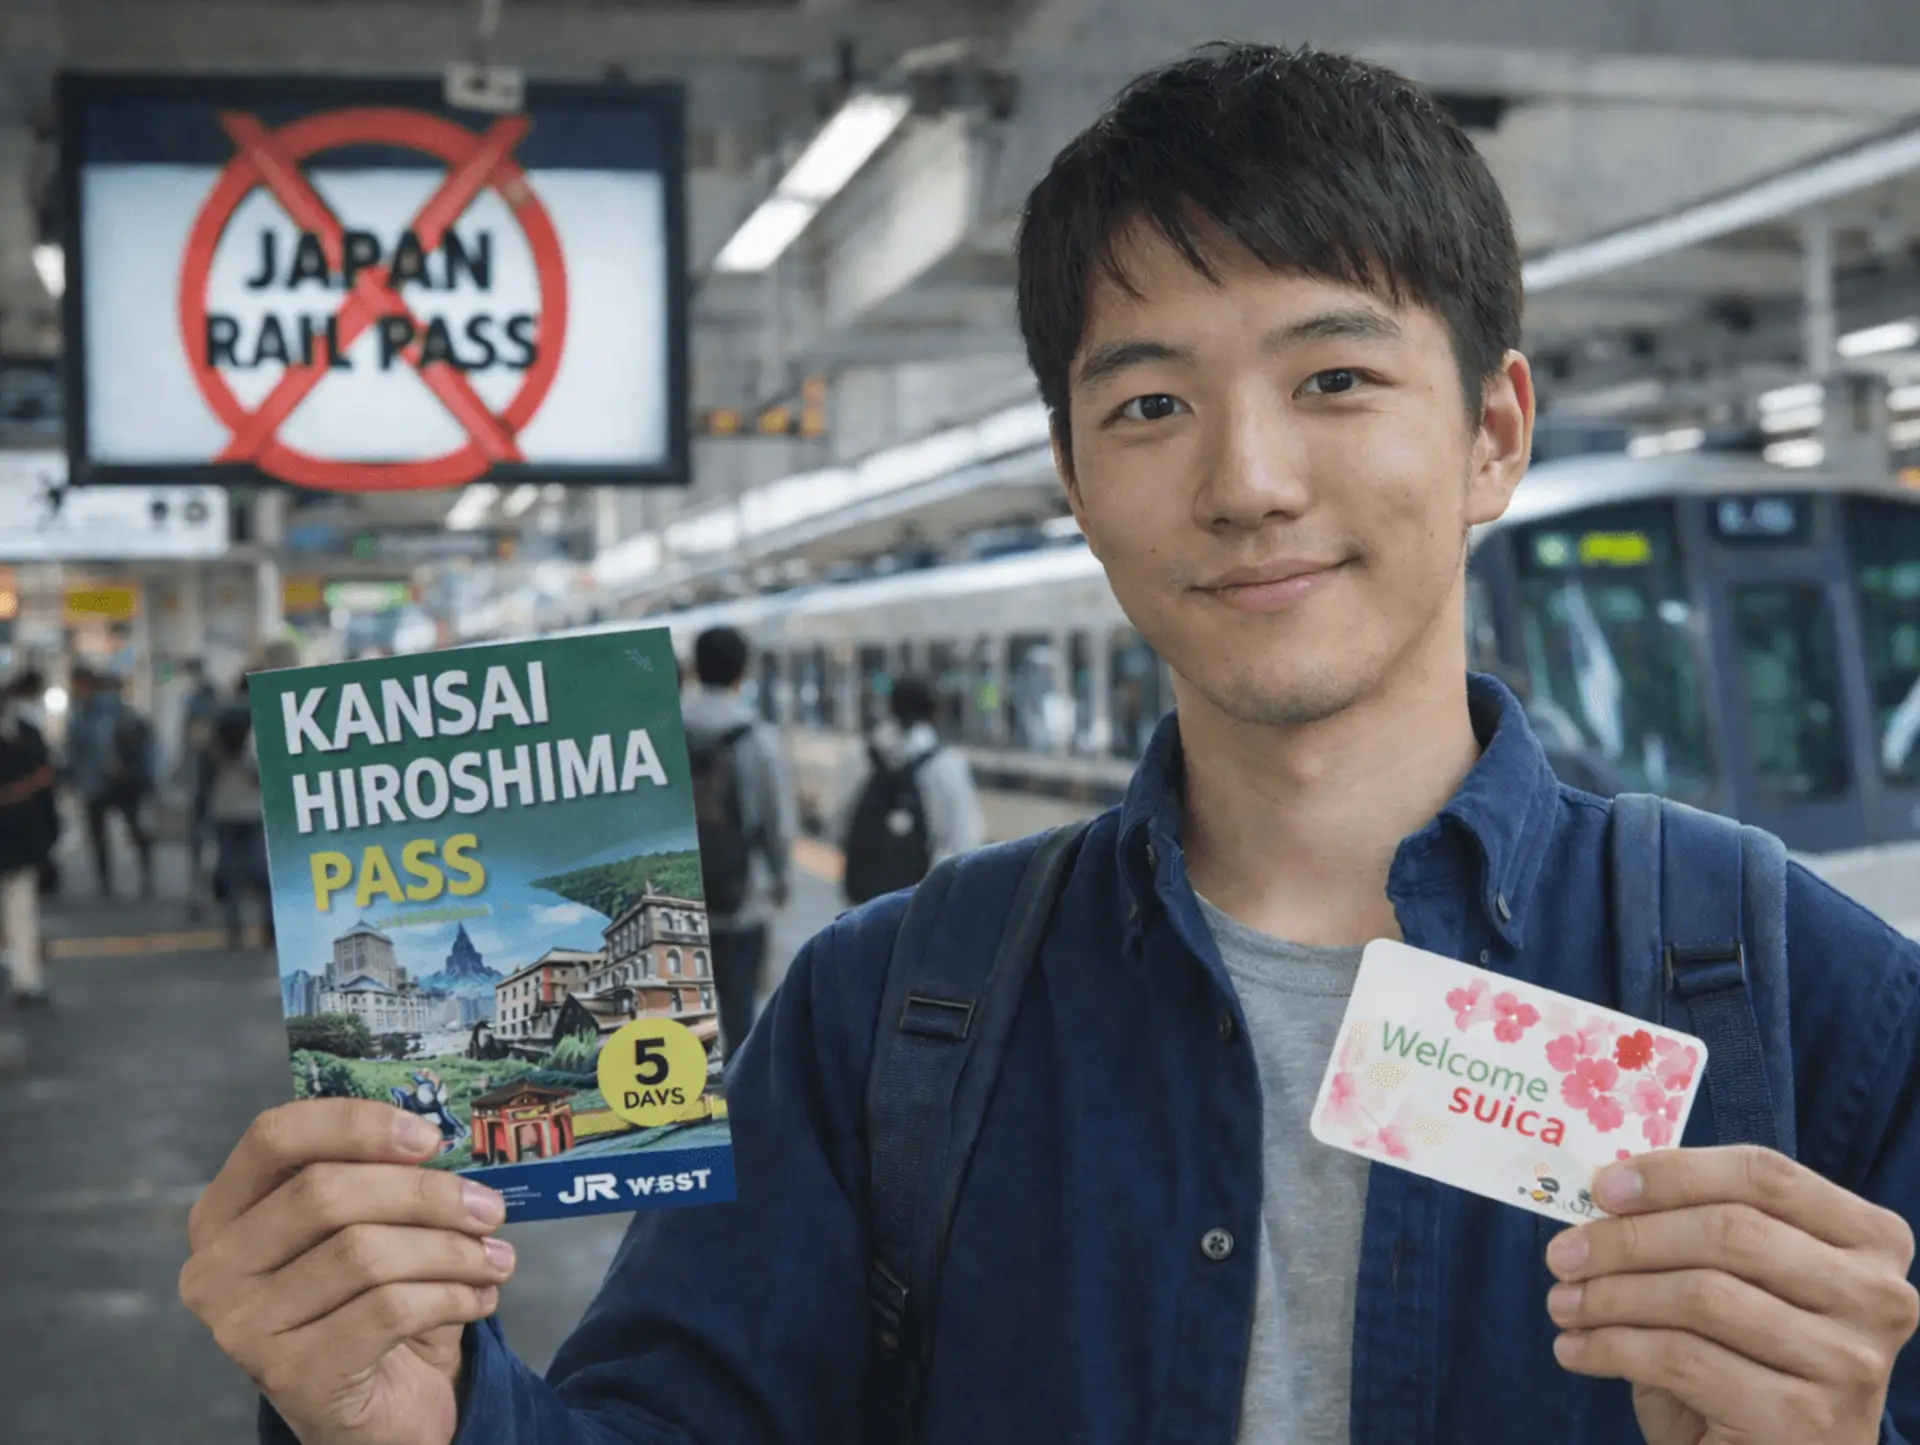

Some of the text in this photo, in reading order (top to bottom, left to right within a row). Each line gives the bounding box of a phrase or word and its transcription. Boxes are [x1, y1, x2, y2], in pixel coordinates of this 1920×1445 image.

[246, 228, 493, 290] JAPAN
[206, 312, 538, 371] RAIL PASS
[280, 660, 549, 755] KANSAI
[291, 728, 669, 834] HIROSHIMA
[308, 833, 486, 912] PASS
[635, 1037, 669, 1085] 5
[1382, 1020, 1549, 1102] Welcome
[1448, 1086, 1567, 1147] suica
[558, 1173, 620, 1204] JR
